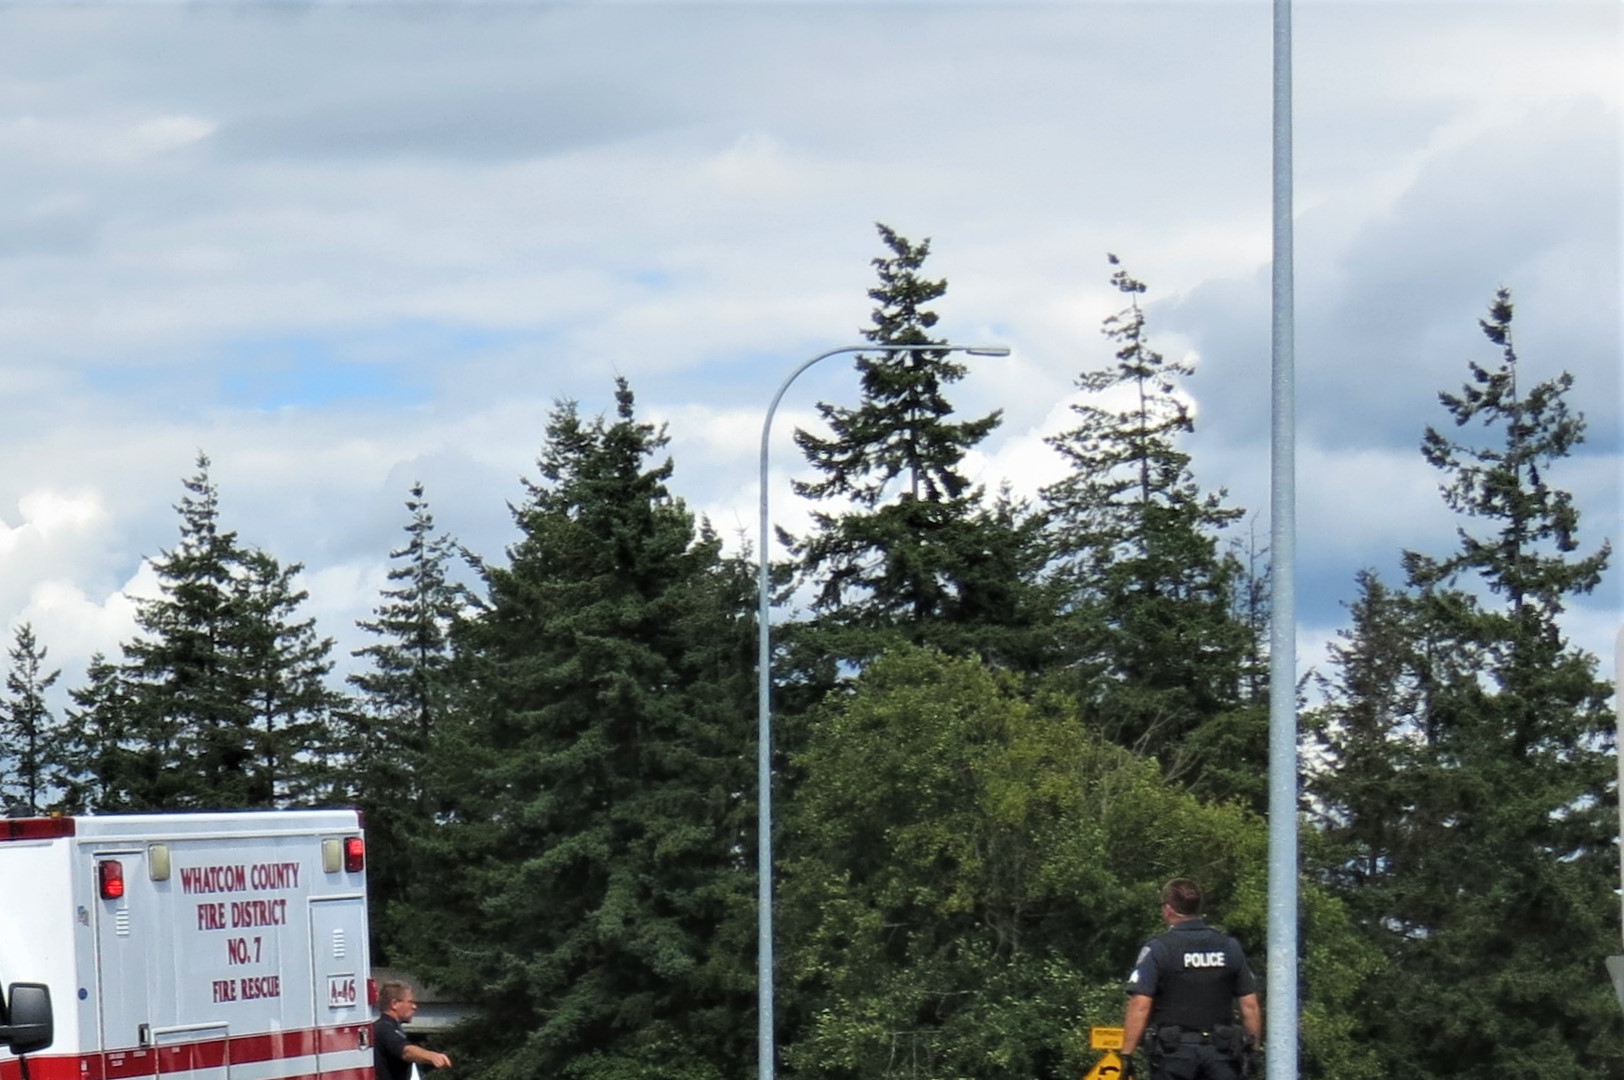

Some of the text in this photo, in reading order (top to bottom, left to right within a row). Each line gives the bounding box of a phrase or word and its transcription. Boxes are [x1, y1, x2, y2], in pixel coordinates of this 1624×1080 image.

[180, 862, 300, 894] WHATCOM COUNTY
[197, 899, 287, 930] FIRE DISTRICT
[227, 937, 262, 965] NO. 7
[1183, 952, 1225, 968] POLICE
[212, 976, 280, 1003] FIRE RESCUE
[330, 979, 356, 1003] A-46
